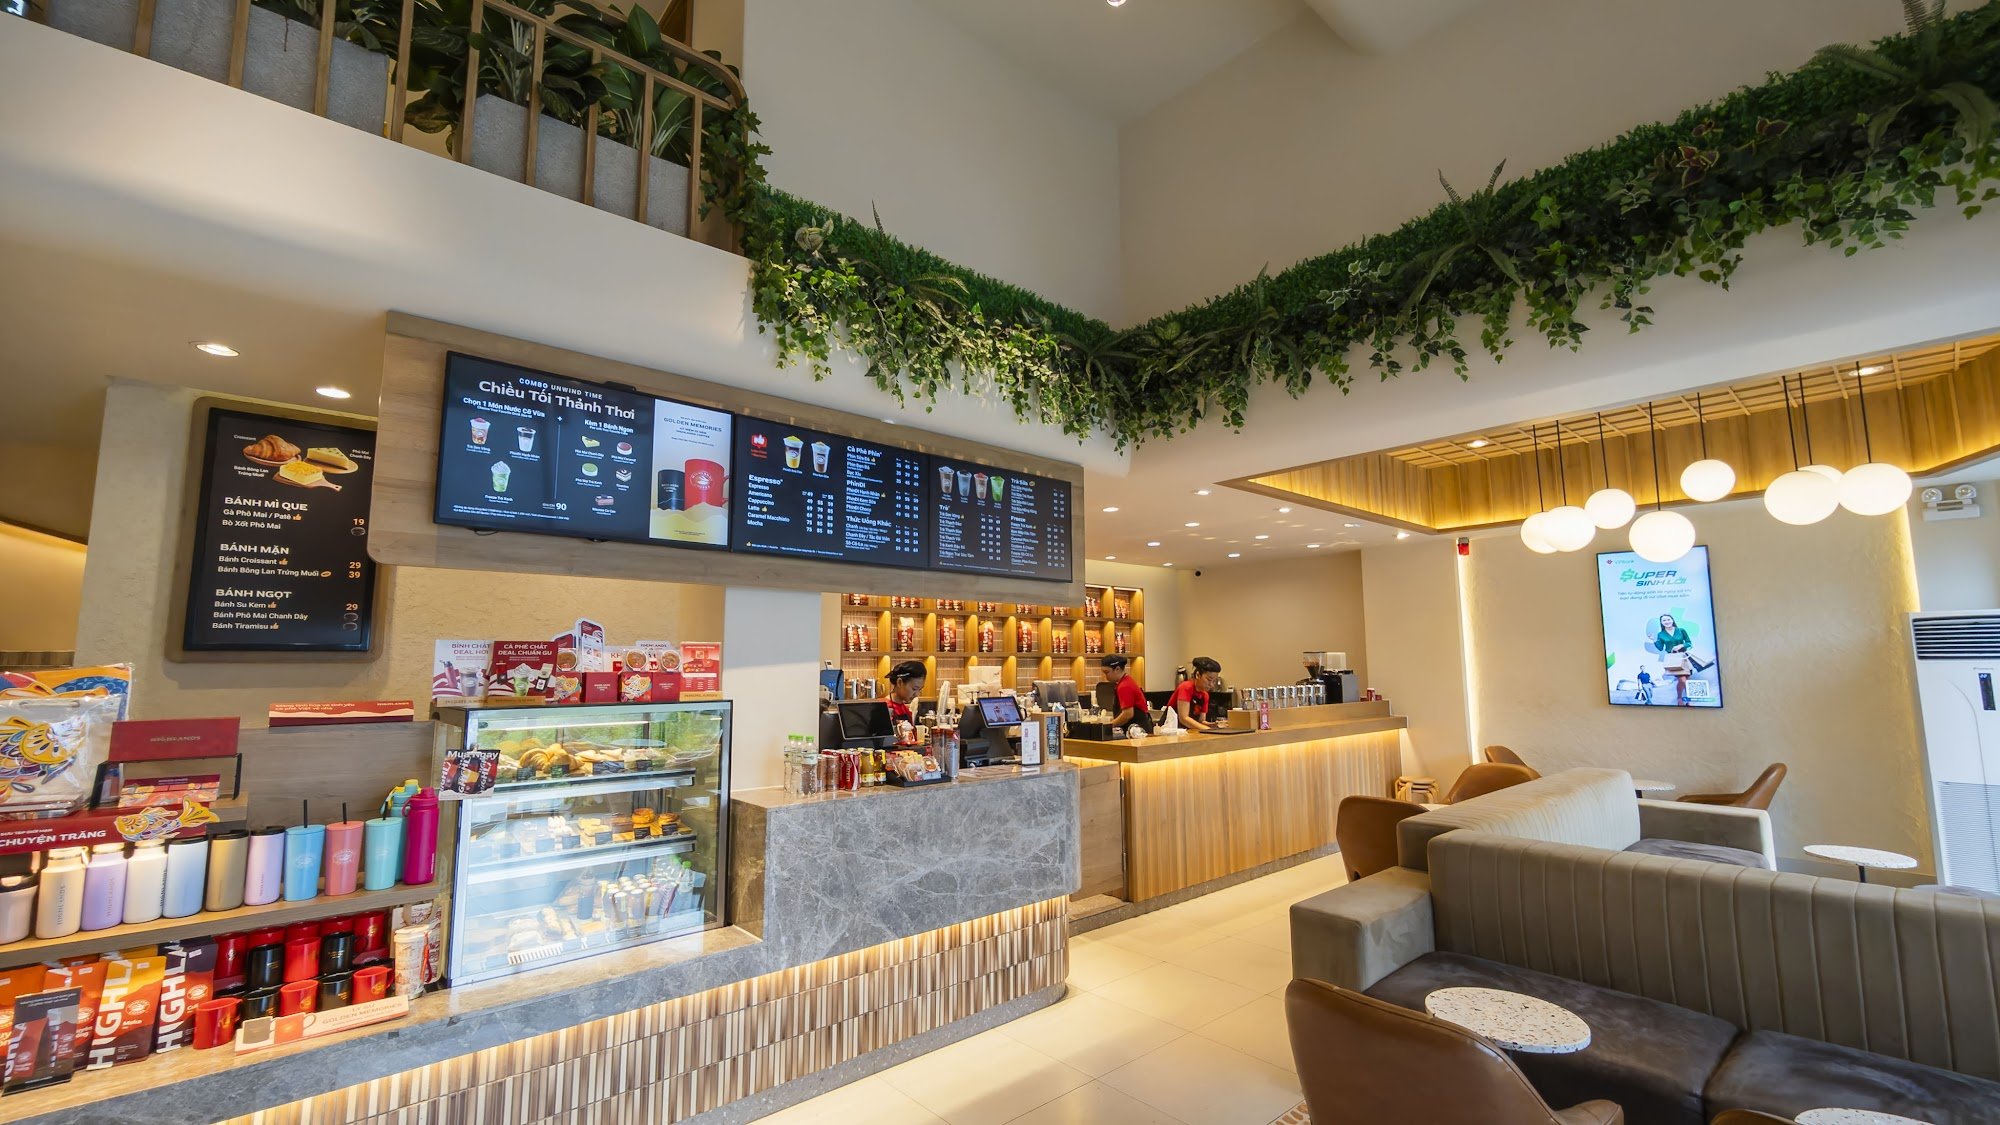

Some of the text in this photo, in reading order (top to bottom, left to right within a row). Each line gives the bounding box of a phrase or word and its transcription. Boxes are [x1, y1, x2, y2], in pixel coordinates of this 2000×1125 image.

[519, 378, 602, 400] COMBO UNWIND TIME
[463, 398, 481, 406] Chọn
[488, 402, 503, 410] Món
[504, 404, 521, 413] Nước
[479, 381, 635, 419] Chiều Tối Thảnh Thơi
[664, 417, 689, 426] GOLDEN
[690, 423, 722, 432] MEMORIES
[224, 496, 308, 511] BÁNH MÌ QUE
[748, 498, 774, 506] Cappuccino
[767, 514, 790, 522] Macchiato
[220, 542, 289, 555] BÁNH MẶN
[240, 566, 260, 575] Bông
[216, 587, 292, 599] BÁNH NGỌT
[59, 830, 106, 841] TRĂNG
